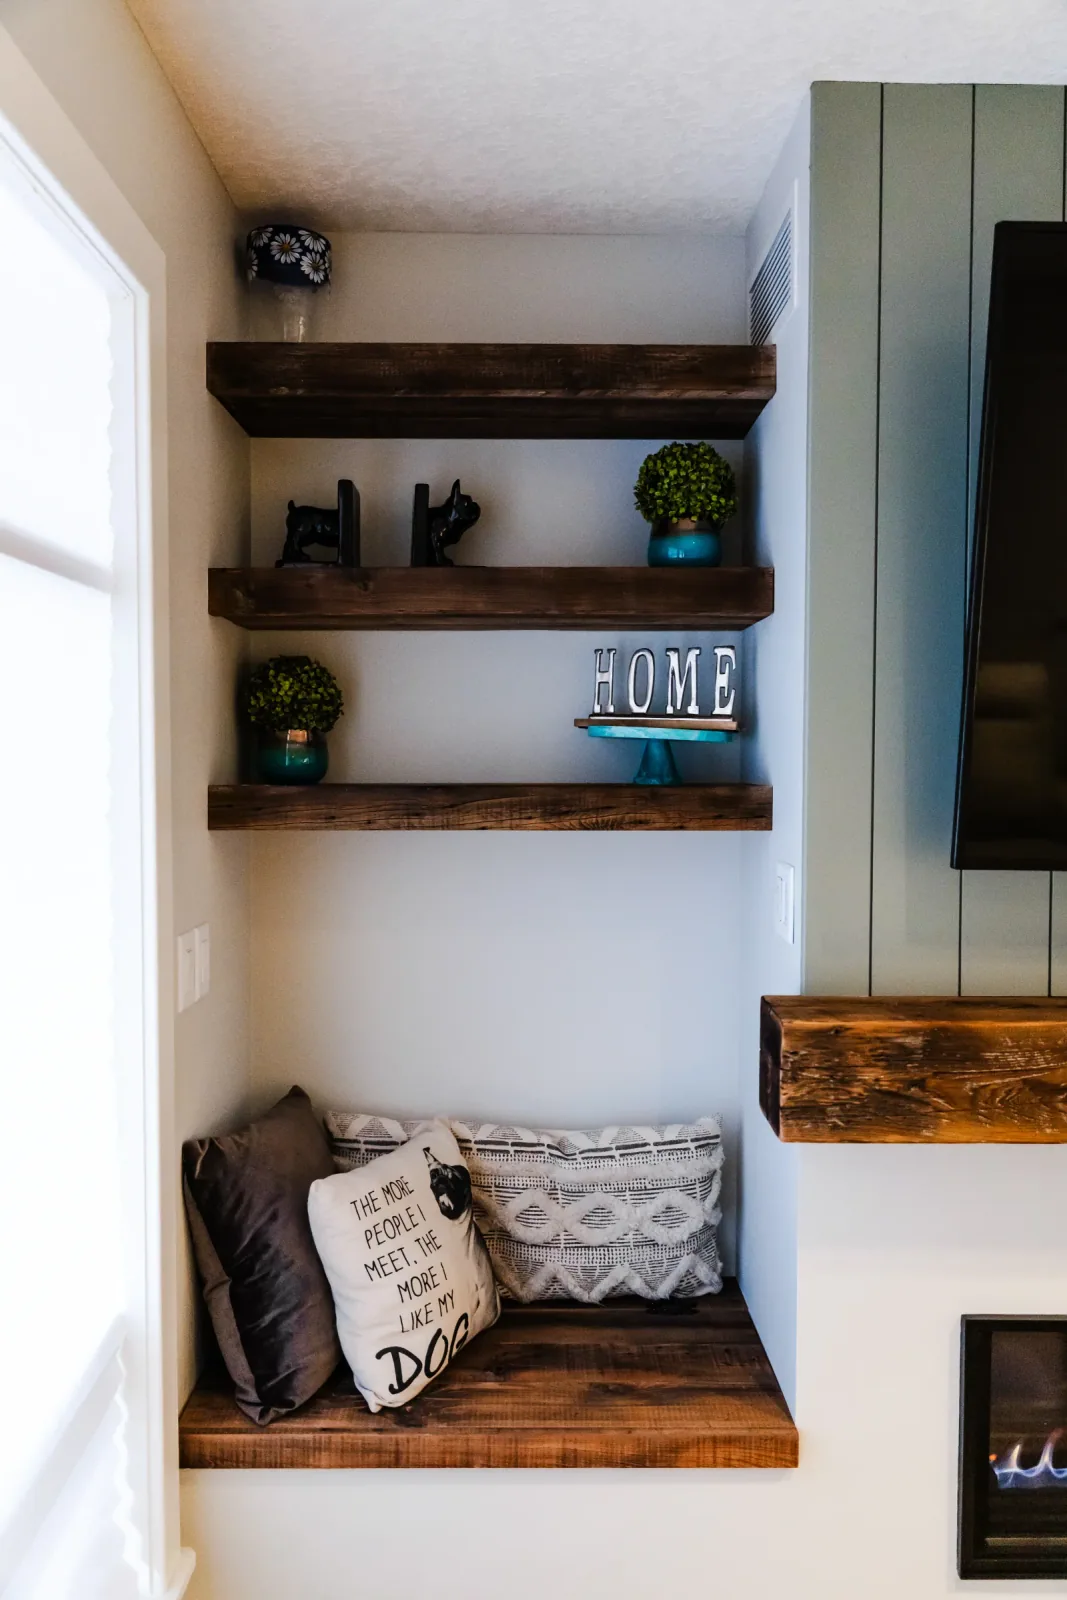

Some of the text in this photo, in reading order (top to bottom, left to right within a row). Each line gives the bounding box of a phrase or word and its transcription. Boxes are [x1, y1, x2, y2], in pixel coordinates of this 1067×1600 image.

[593, 645, 737, 715] HOME
[350, 1175, 415, 1221] THE MORE
[364, 1204, 427, 1250] PEOPLE I
[414, 1229, 443, 1258] THE
[397, 1262, 448, 1304] MORE I
[399, 1289, 455, 1334] LIKE MY
[375, 1312, 469, 1395] DOG
